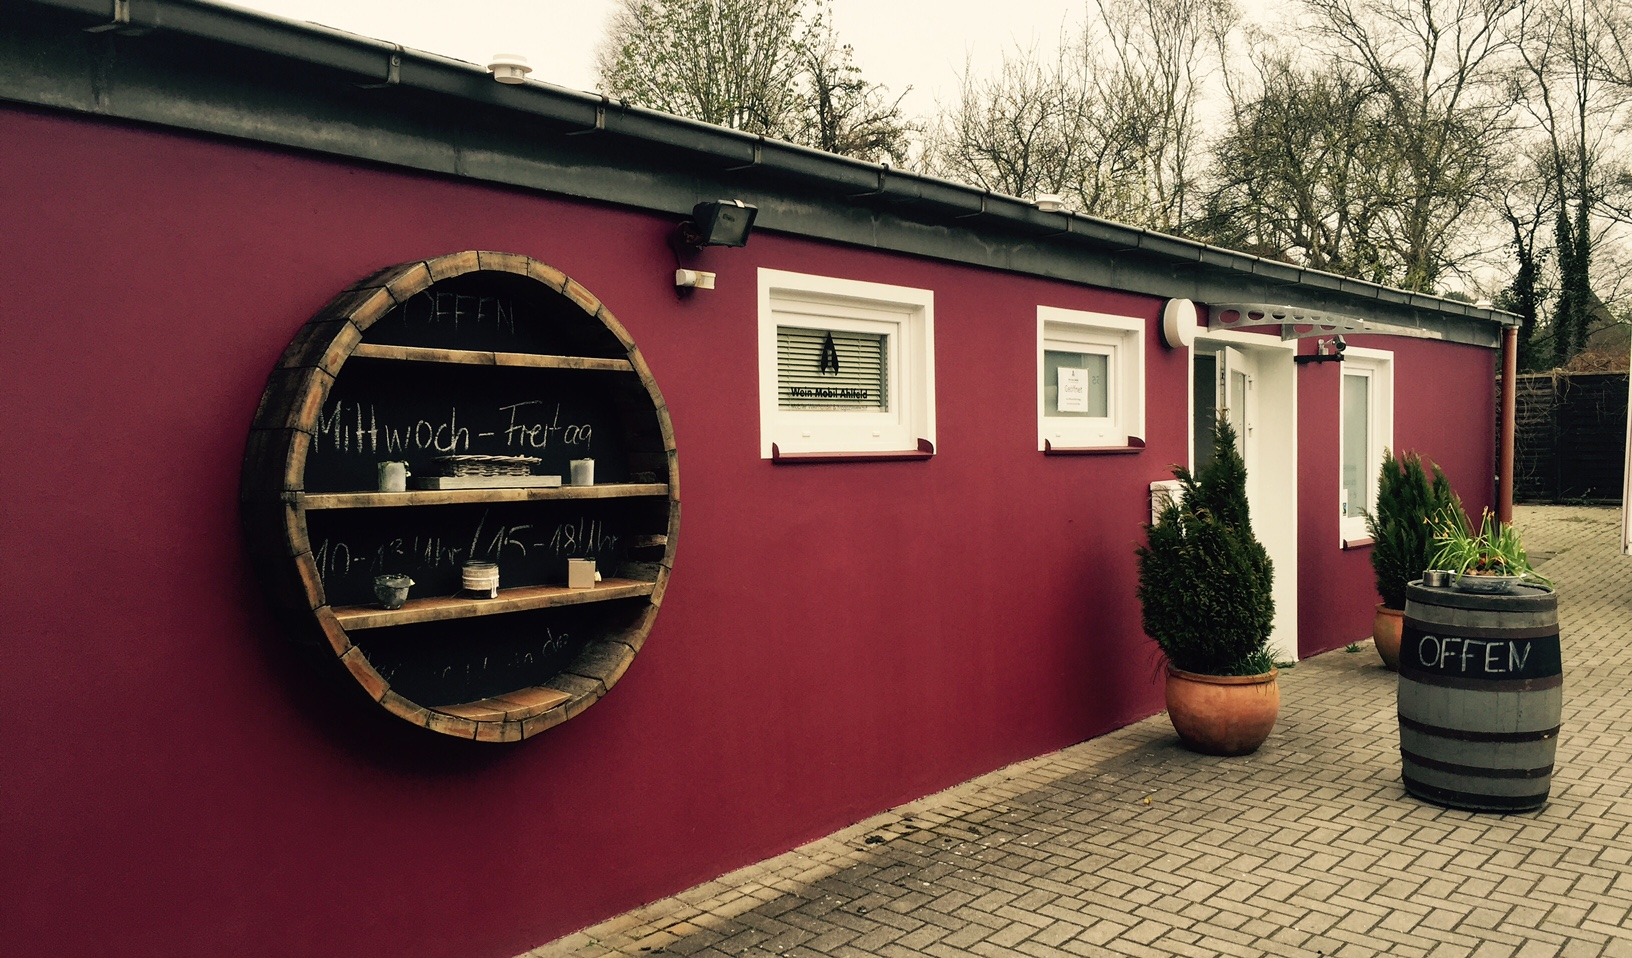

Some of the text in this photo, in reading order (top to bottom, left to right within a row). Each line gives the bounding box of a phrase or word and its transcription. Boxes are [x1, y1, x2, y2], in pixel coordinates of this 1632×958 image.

[790, 386, 868, 399] Wein Mobil Ahlfeld
[1418, 635, 1532, 673] OFFEN
